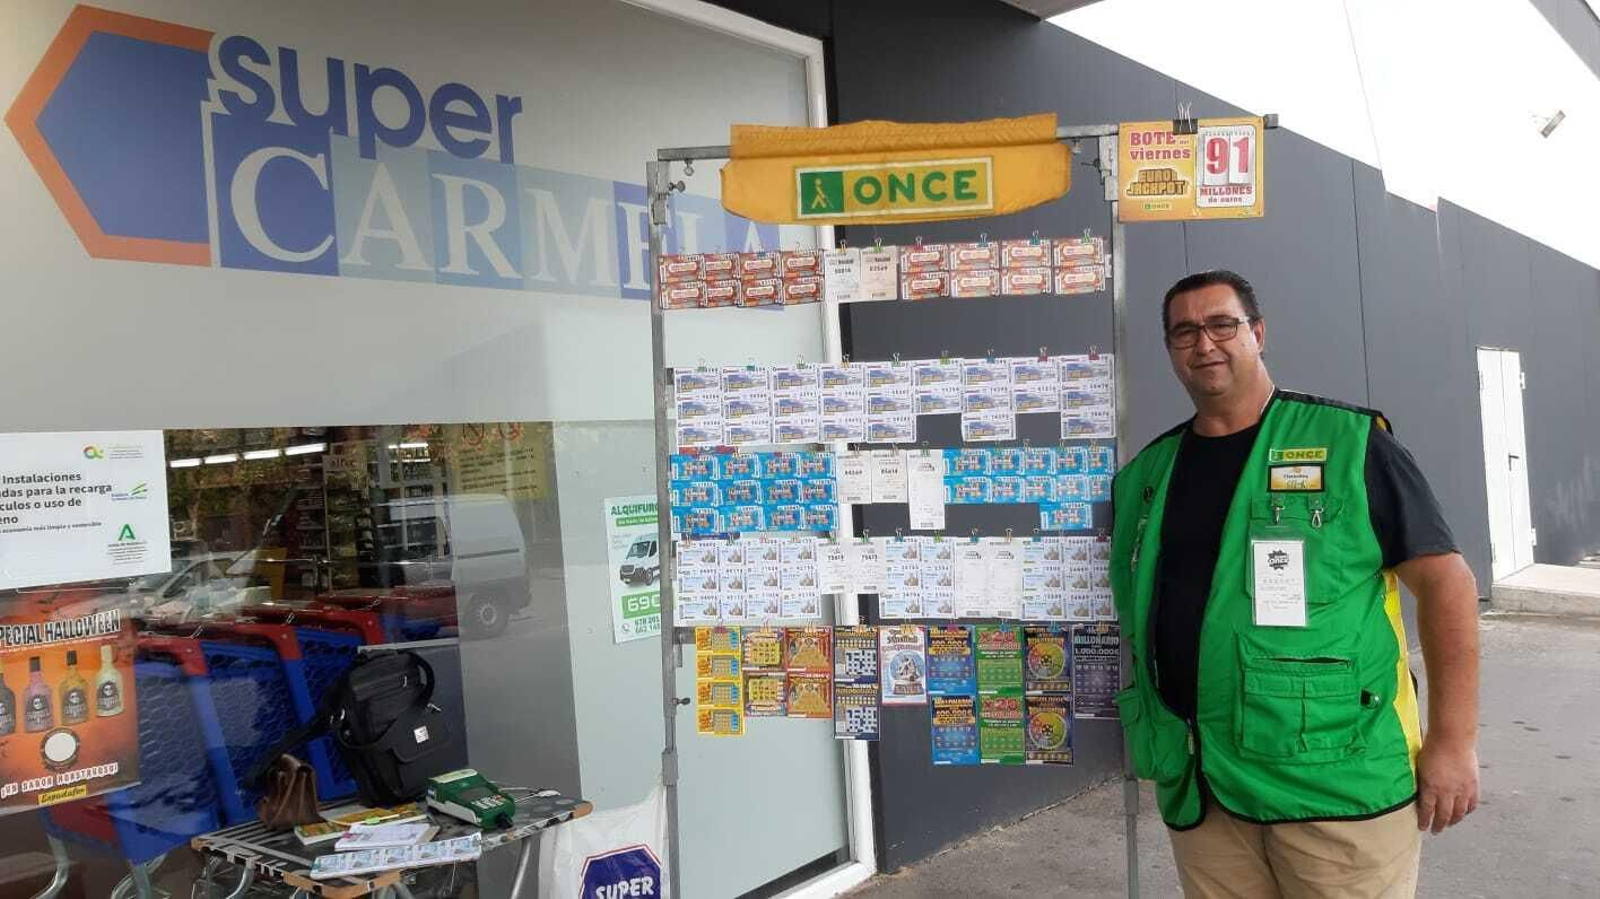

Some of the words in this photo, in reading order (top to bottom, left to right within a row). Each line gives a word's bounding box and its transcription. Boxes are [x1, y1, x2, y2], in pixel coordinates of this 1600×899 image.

[218, 35, 523, 164] super
[1130, 131, 1176, 146] BOTE
[1130, 148, 1191, 160] viernes
[1206, 137, 1250, 175] 91
[853, 169, 978, 205] ONCE
[1127, 181, 1186, 196] JACKPOT
[1200, 186, 1252, 196] MILLONES
[1285, 450, 1325, 460] ONCE
[2, 473, 82, 484] Instalaciones
[26, 486, 53, 498] para
[56, 485, 66, 495] la
[69, 484, 112, 494] recarga
[44, 500, 65, 509] uso
[68, 498, 82, 507] de
[44, 610, 120, 642] HALLOWEEN
[21, 775, 53, 793] SABOR
[596, 876, 655, 899] SUPER
